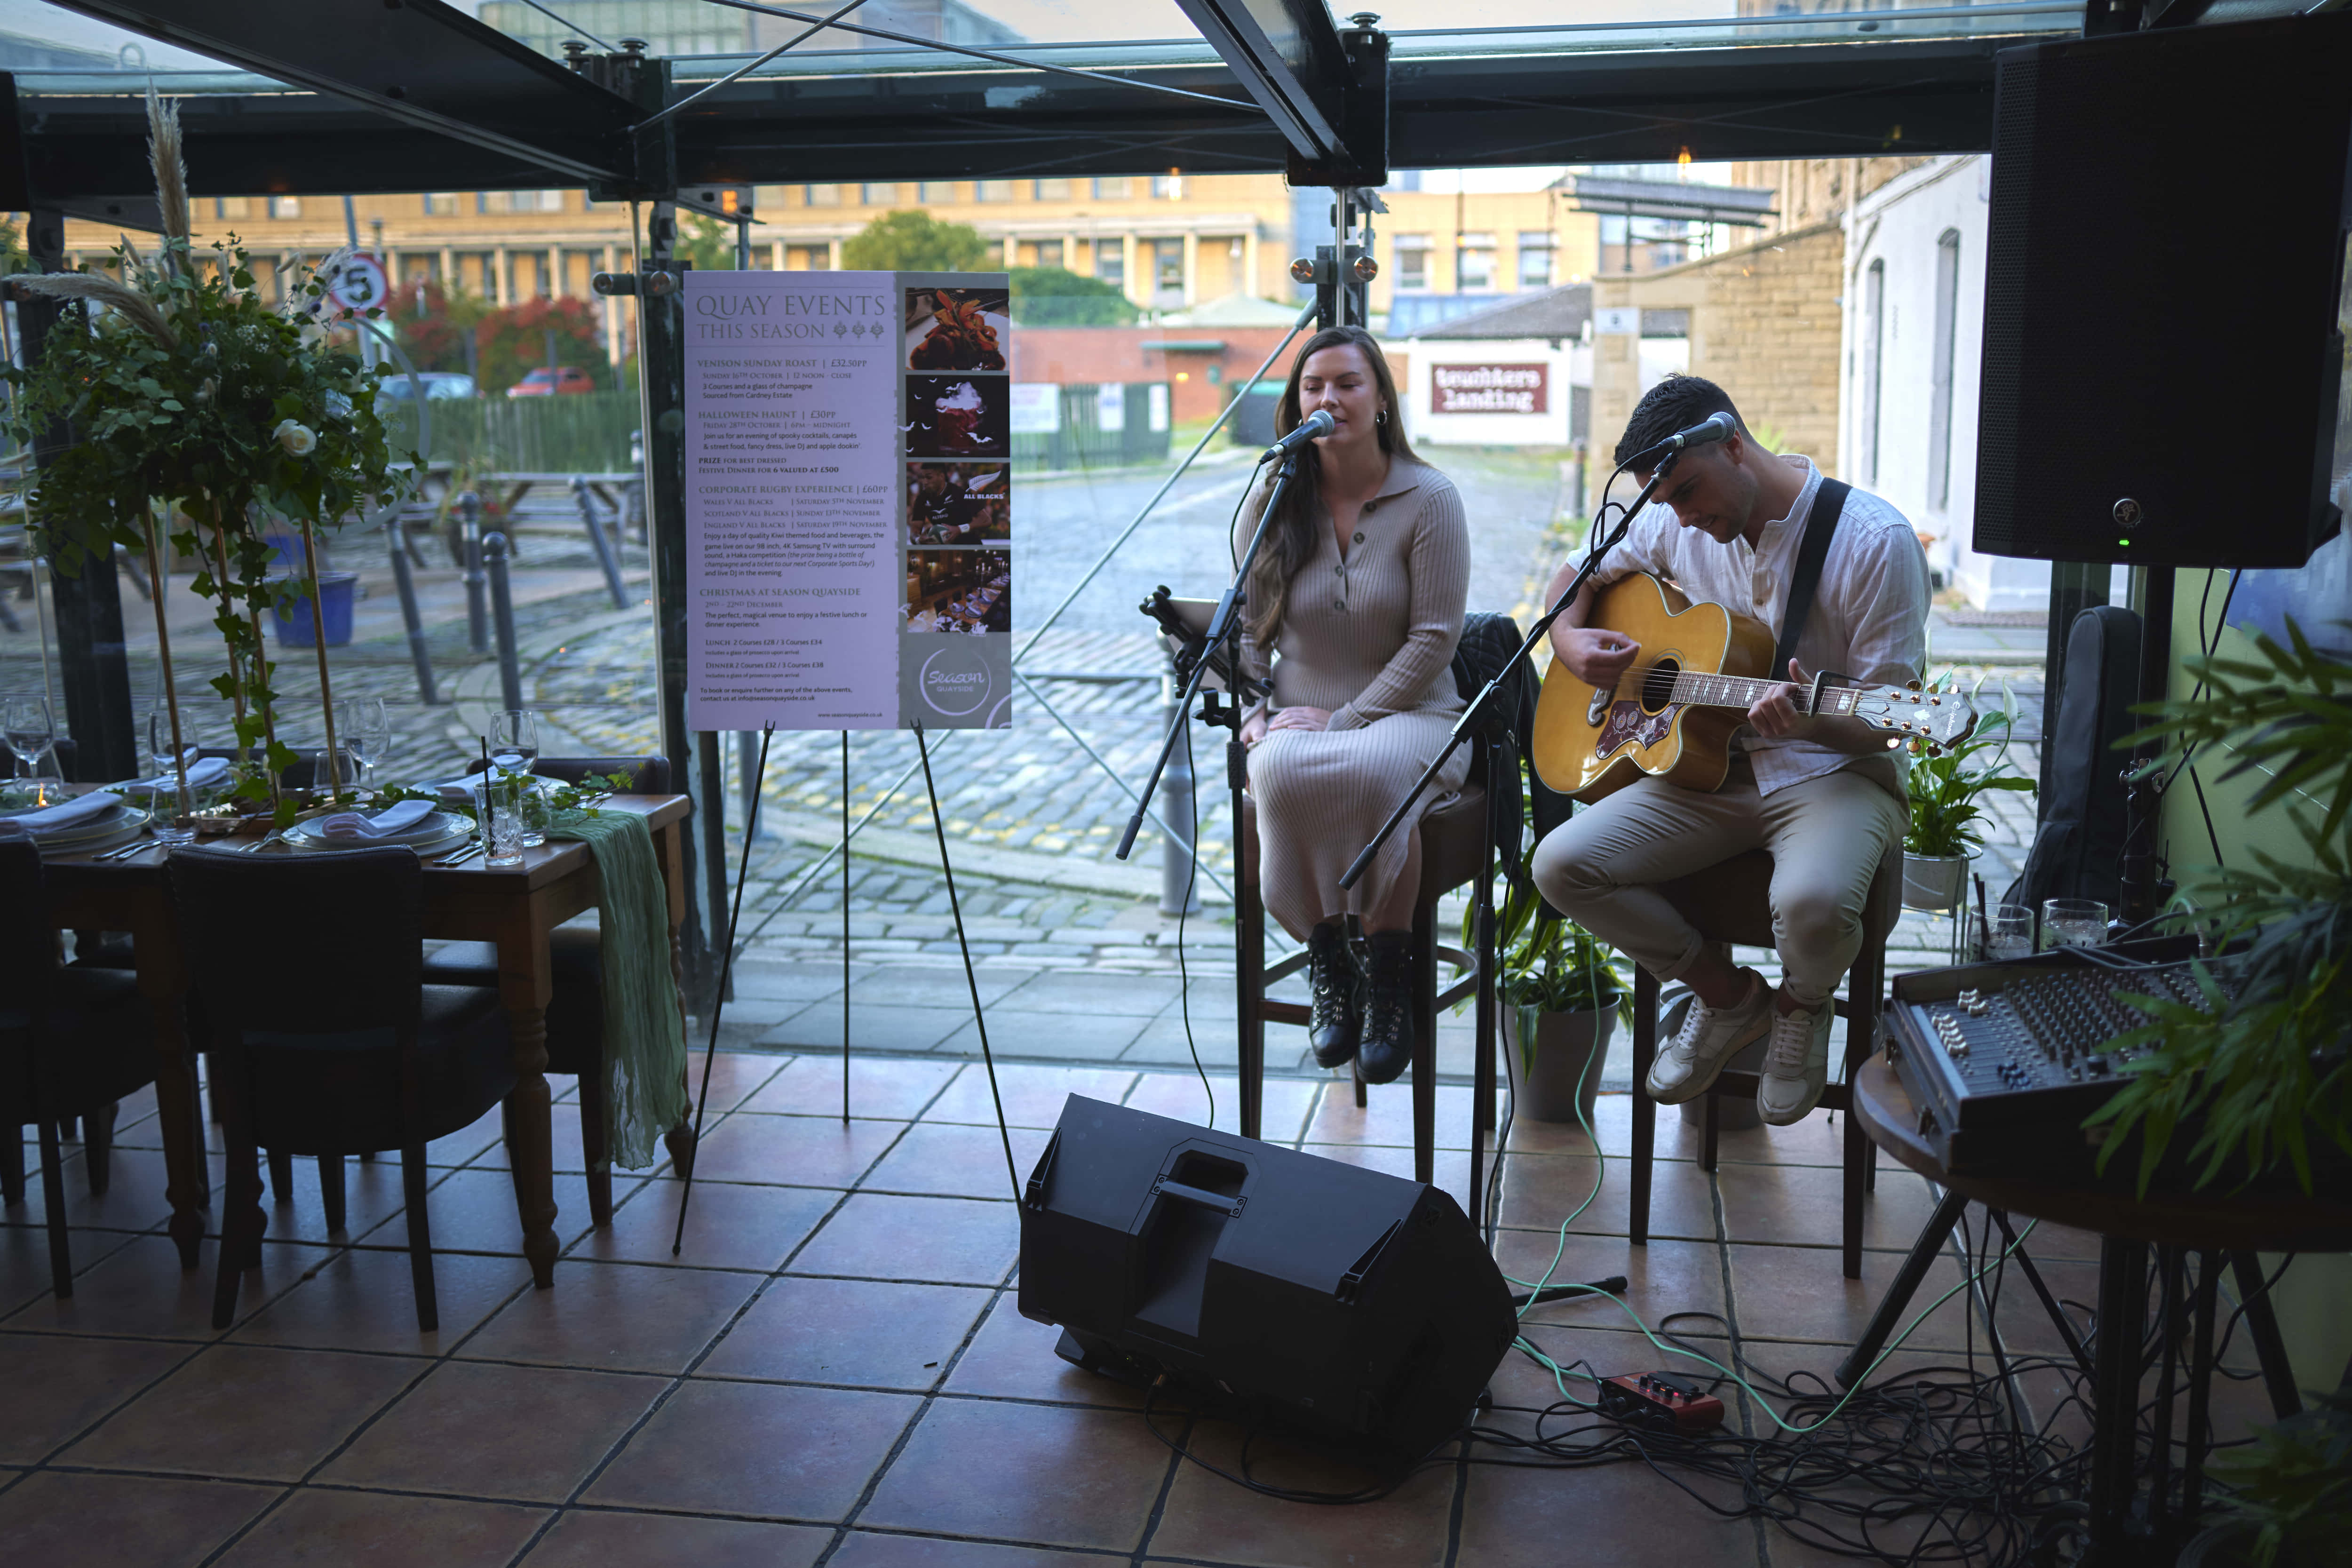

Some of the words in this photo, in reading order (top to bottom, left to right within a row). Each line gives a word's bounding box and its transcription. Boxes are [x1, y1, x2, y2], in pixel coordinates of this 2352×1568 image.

[346, 267, 372, 302] 5
[696, 295, 772, 320] QUAY
[785, 295, 885, 315] EVENTS
[697, 324, 743, 338] THIS
[751, 324, 825, 338] SEASON
[812, 588, 860, 597] QUAYSIDE
[927, 670, 985, 684] Season
[1946, 700, 1961, 736] Epiphone
